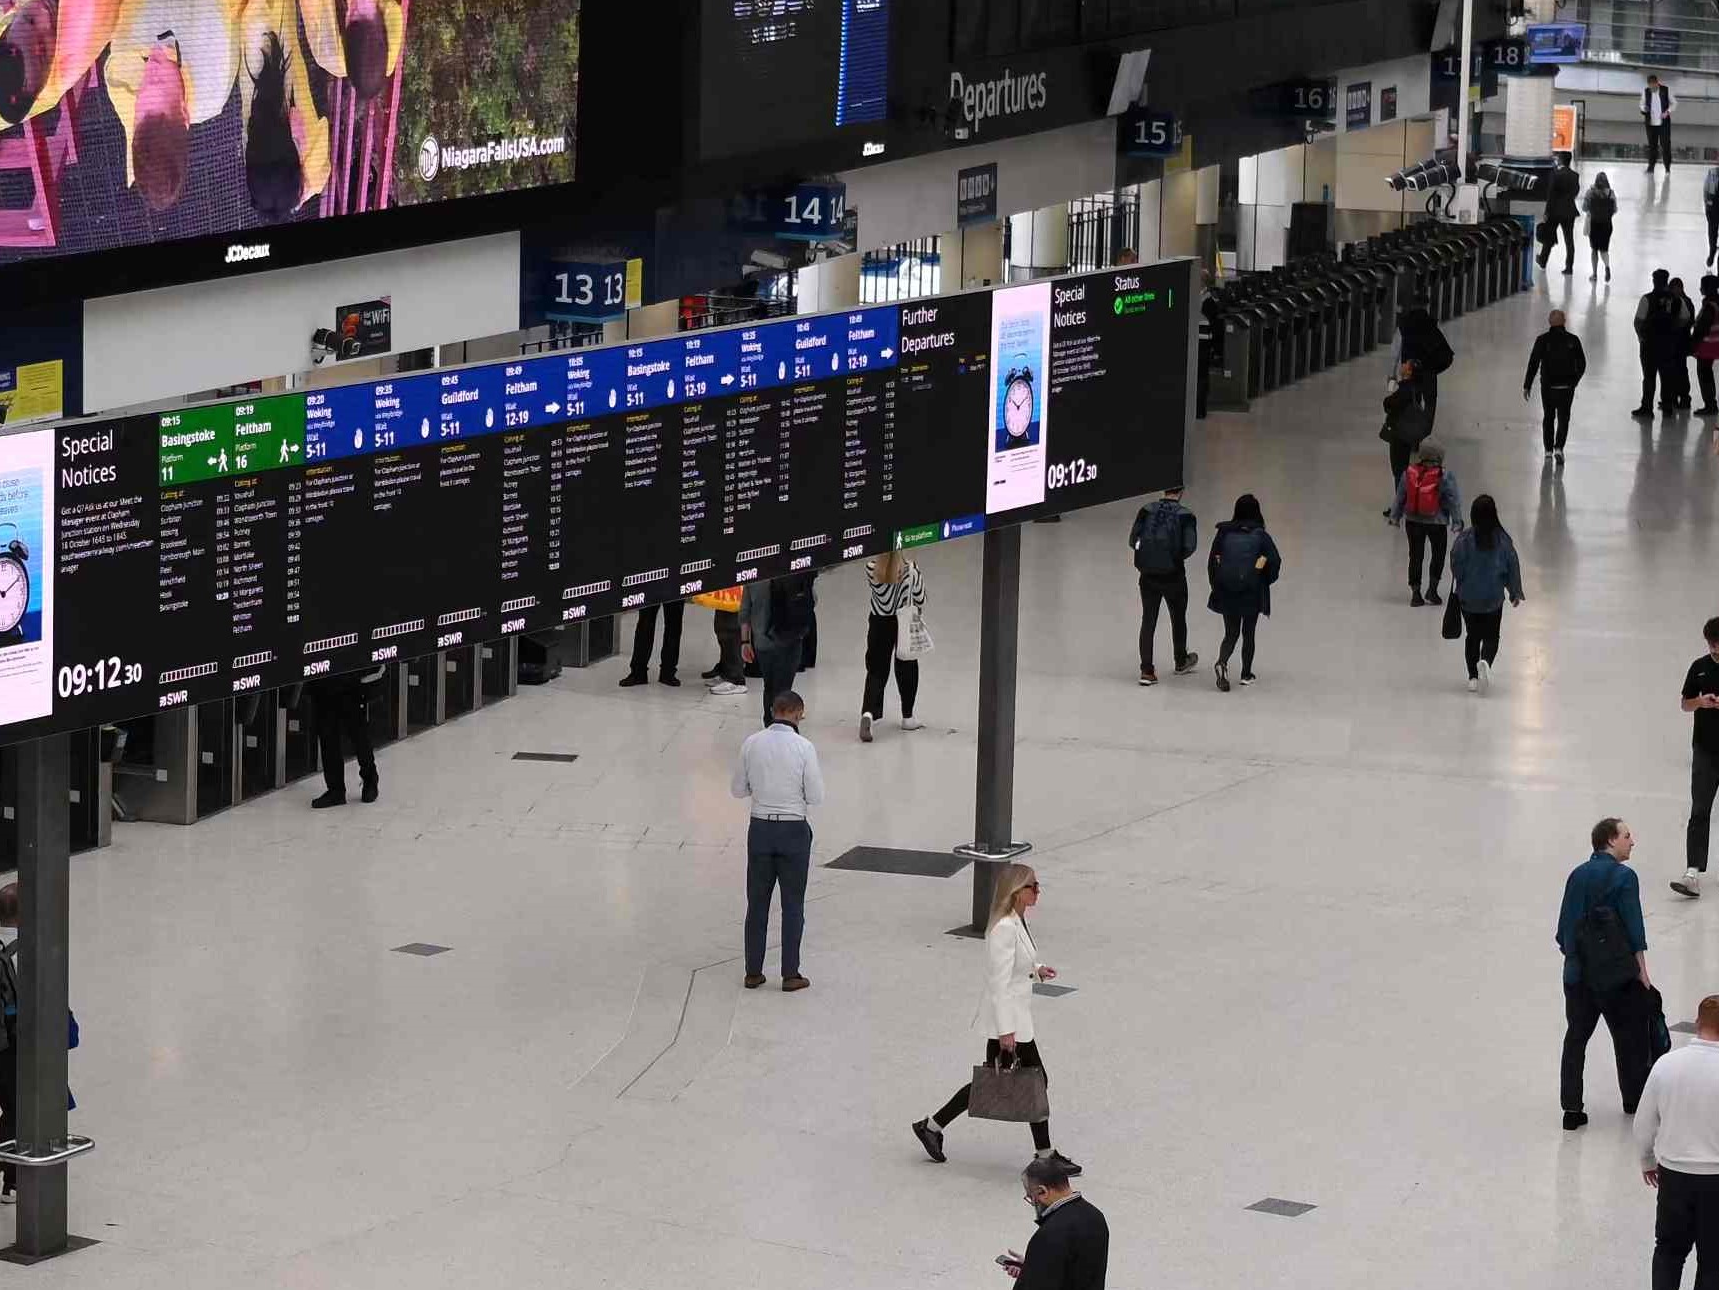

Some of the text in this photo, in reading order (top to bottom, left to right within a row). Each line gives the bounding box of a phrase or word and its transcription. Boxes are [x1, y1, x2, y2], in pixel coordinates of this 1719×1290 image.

[1493, 46, 1520, 66] 18
[949, 69, 1048, 132] Departures
[1294, 86, 1323, 110] 16
[1134, 120, 1168, 146] 15
[441, 136, 566, 171] NiagaraFallsUSA.com
[784, 194, 823, 226] 14
[829, 195, 845, 225] 14
[224, 242, 271, 264] JCDecaux
[554, 272, 594, 306] 13
[603, 272, 623, 305] 13
[1114, 275, 1140, 292] Status
[1054, 284, 1086, 308] Special
[372, 308, 391, 326] WiFi
[901, 306, 939, 327] Further
[1054, 310, 1087, 329] Notices
[795, 334, 827, 351] Guildford
[848, 328, 875, 342] Feltham
[901, 331, 955, 357] Departures
[627, 360, 670, 378] Basingstoke
[685, 354, 715, 368] Feltham
[847, 354, 868, 370] 12-19
[567, 368, 590, 381] Woking
[794, 364, 811, 380] 5-11
[441, 375, 459, 387] 09:45
[505, 381, 538, 396] Feltham
[740, 374, 757, 389] 5-11
[441, 388, 479, 406] Guildford
[684, 382, 707, 398] 12-19
[306, 394, 325, 406] 09:20
[375, 397, 401, 409] Woking
[626, 392, 644, 408] 5-11
[235, 404, 254, 417] 09:19
[306, 408, 332, 420] Woking
[566, 401, 584, 417] 5-11
[161, 415, 181, 428] 09:15
[505, 410, 529, 427] 12-19
[235, 421, 272, 437] Feltham
[440, 421, 460, 438] 5-11
[62, 429, 114, 462] Special
[161, 428, 216, 448] Basingstoke
[374, 431, 395, 448] 5-11
[306, 442, 327, 459] 5-11
[235, 454, 248, 470] 16
[61, 464, 117, 489] Notices
[161, 466, 174, 482] 11
[1047, 458, 1086, 490] 09:12
[1086, 464, 1098, 482] 30
[847, 543, 864, 557] SWR
[795, 555, 812, 570] SWR
[741, 567, 758, 581] SWR
[686, 580, 702, 593] SWR
[628, 591, 645, 606] SWR
[568, 605, 587, 619] SWR
[507, 617, 526, 632] SWR
[444, 631, 463, 647] SWR
[377, 645, 398, 661] SWR
[309, 660, 331, 675] SWR
[57, 655, 123, 699] 09:12
[124, 661, 144, 687] 30
[238, 674, 261, 691] SWR
[167, 689, 188, 705] SWR
